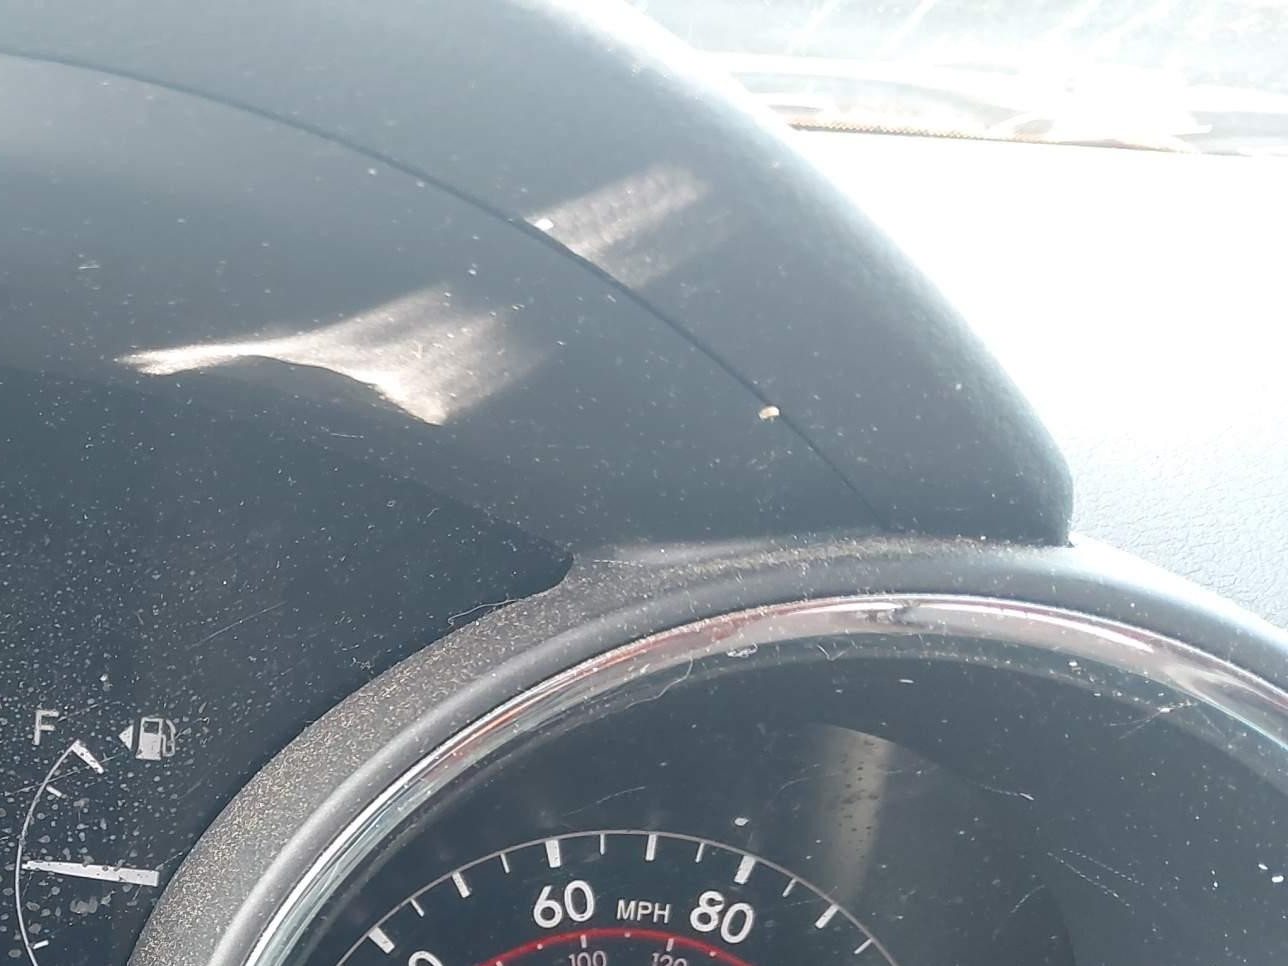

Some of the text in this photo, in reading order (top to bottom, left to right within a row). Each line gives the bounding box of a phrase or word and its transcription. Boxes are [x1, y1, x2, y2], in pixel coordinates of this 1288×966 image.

[34, 709, 59, 745] F
[533, 881, 596, 928] 60
[615, 900, 671, 924] MPH
[689, 890, 755, 943] 80
